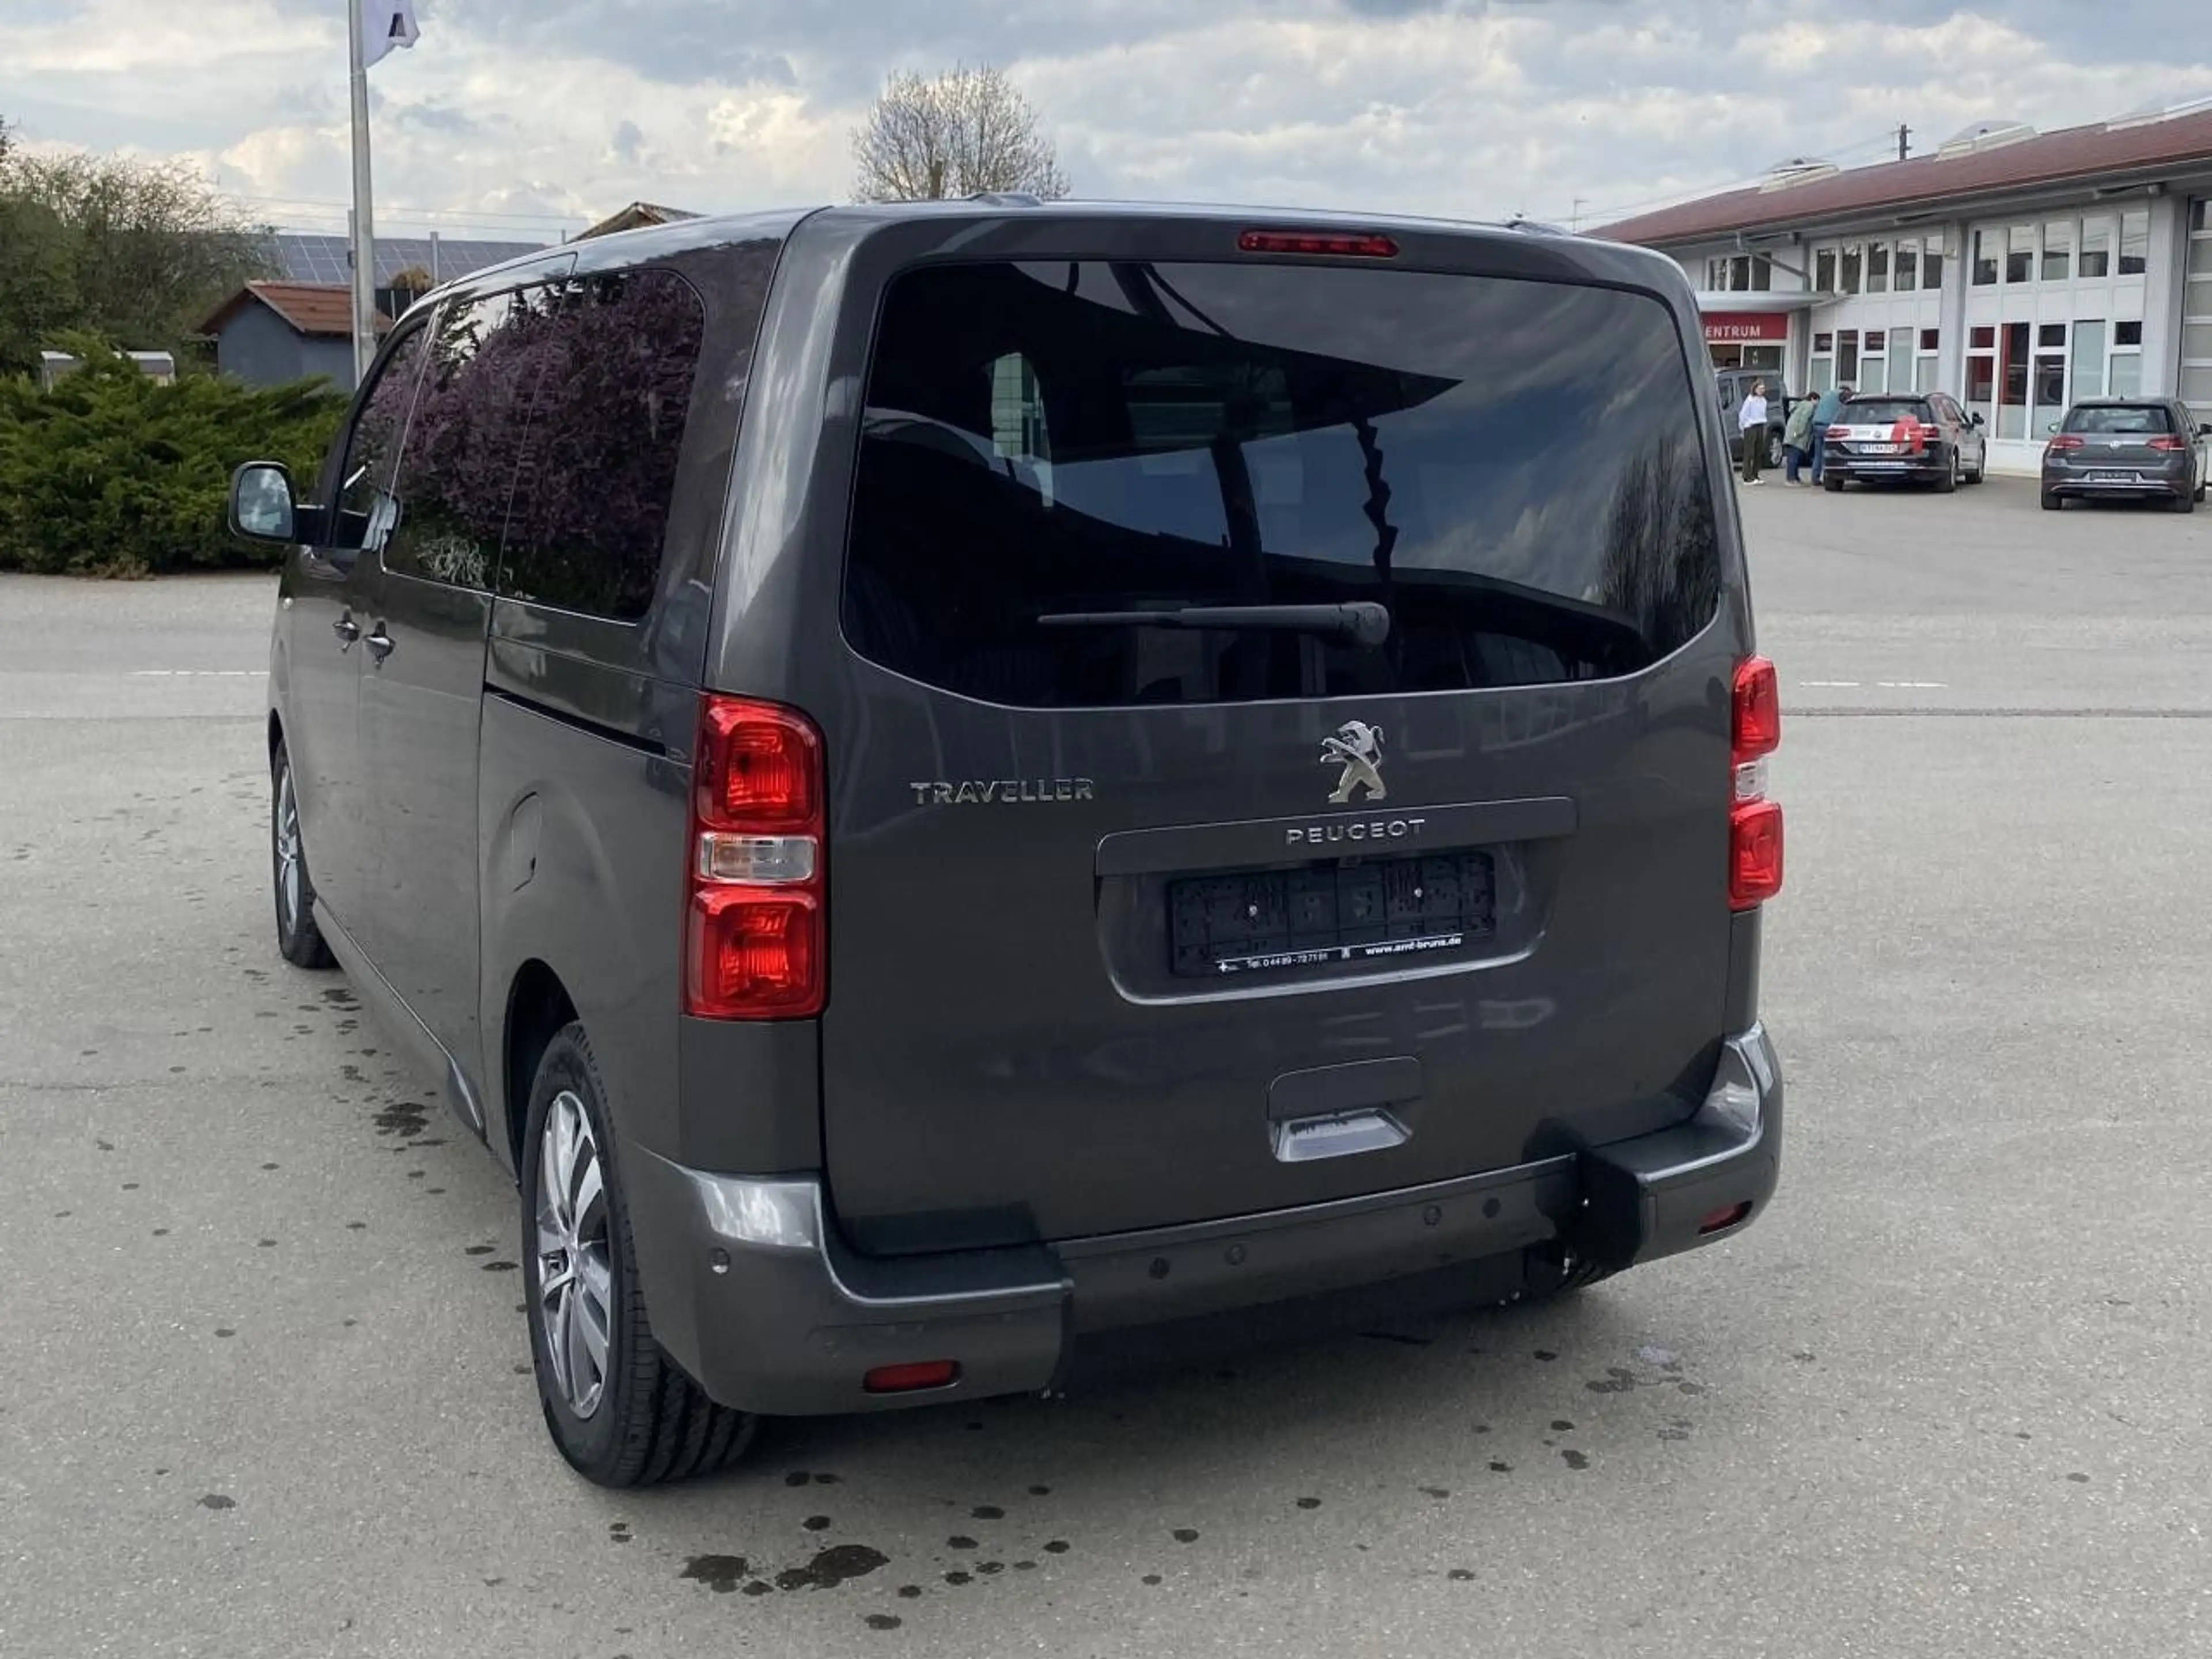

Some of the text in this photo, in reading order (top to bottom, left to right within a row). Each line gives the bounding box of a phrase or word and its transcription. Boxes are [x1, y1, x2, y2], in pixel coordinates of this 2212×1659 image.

[1702, 325, 1760, 338] ENTRUM
[910, 778, 1093, 804] TRAVELLER
[1286, 819, 1425, 844] PEUGEOT
